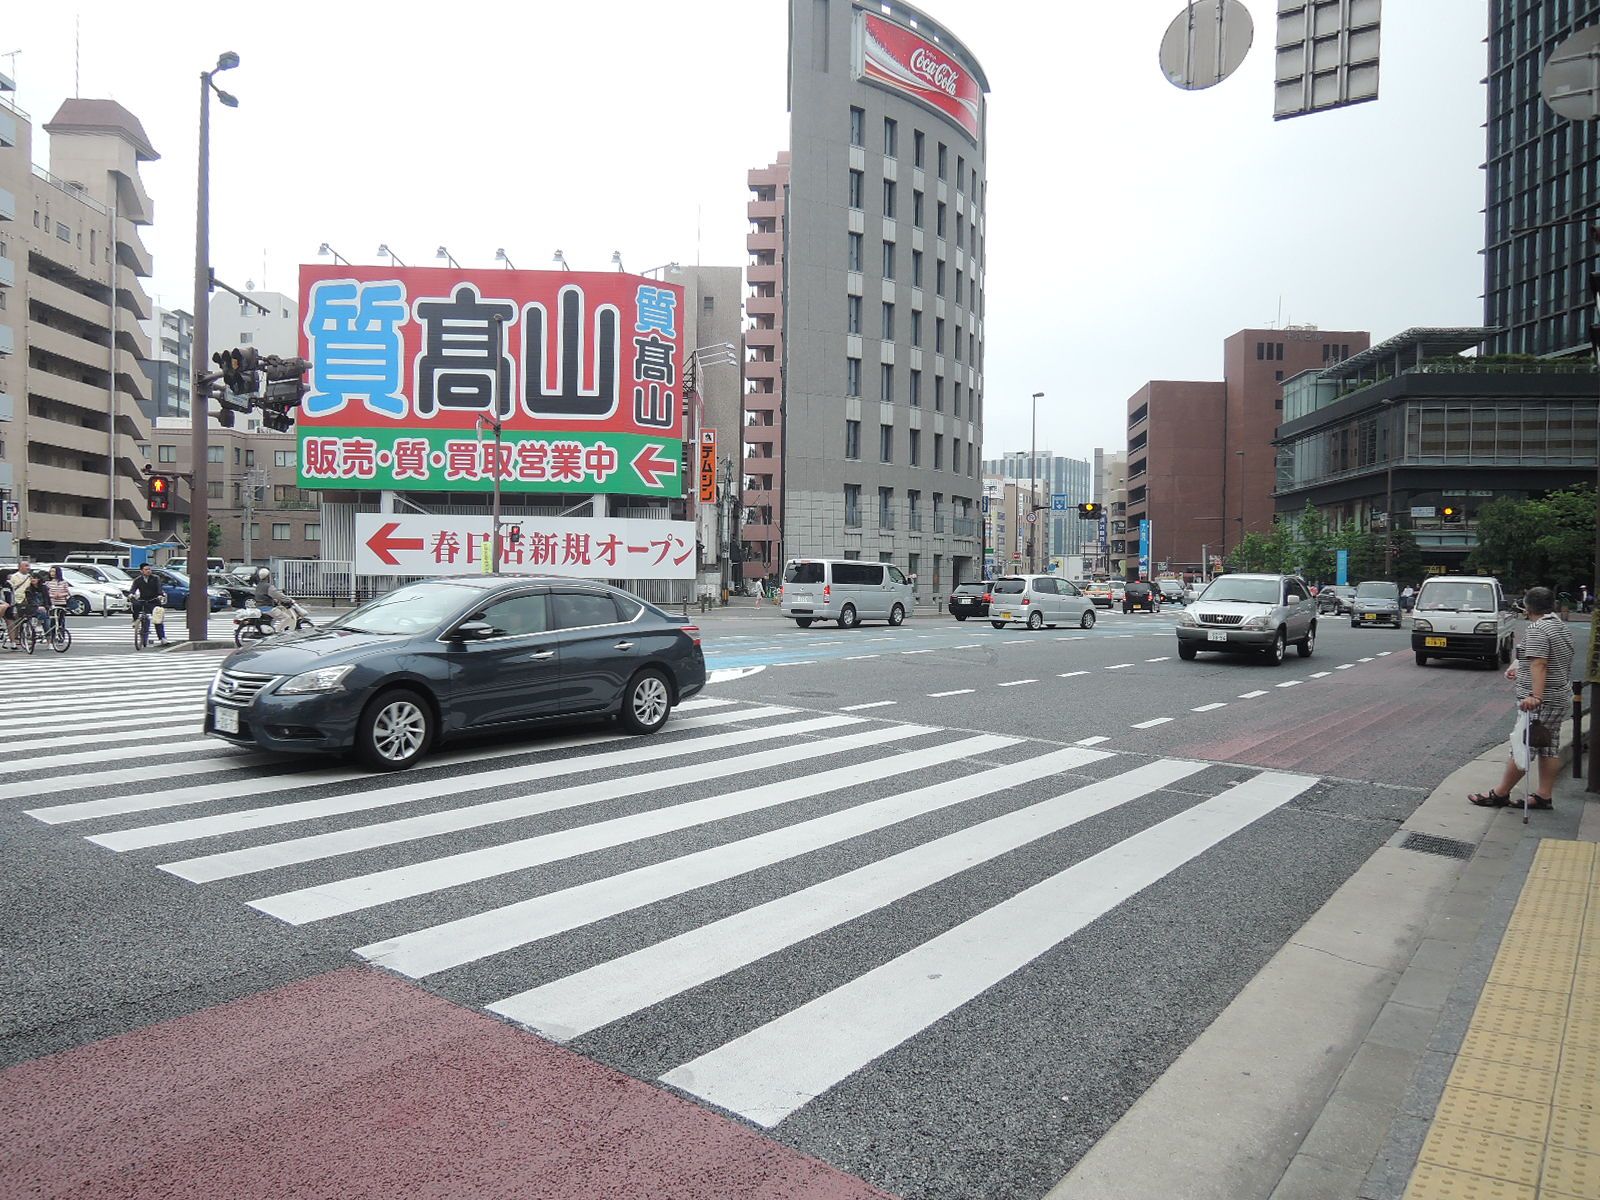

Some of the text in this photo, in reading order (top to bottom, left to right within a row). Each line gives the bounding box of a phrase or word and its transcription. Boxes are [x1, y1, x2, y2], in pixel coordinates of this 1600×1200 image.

[910, 48, 960, 95] Coca-Cola
[701, 445, 713, 501] テムジン
[430, 530, 694, 567] 春日店新規オープン
